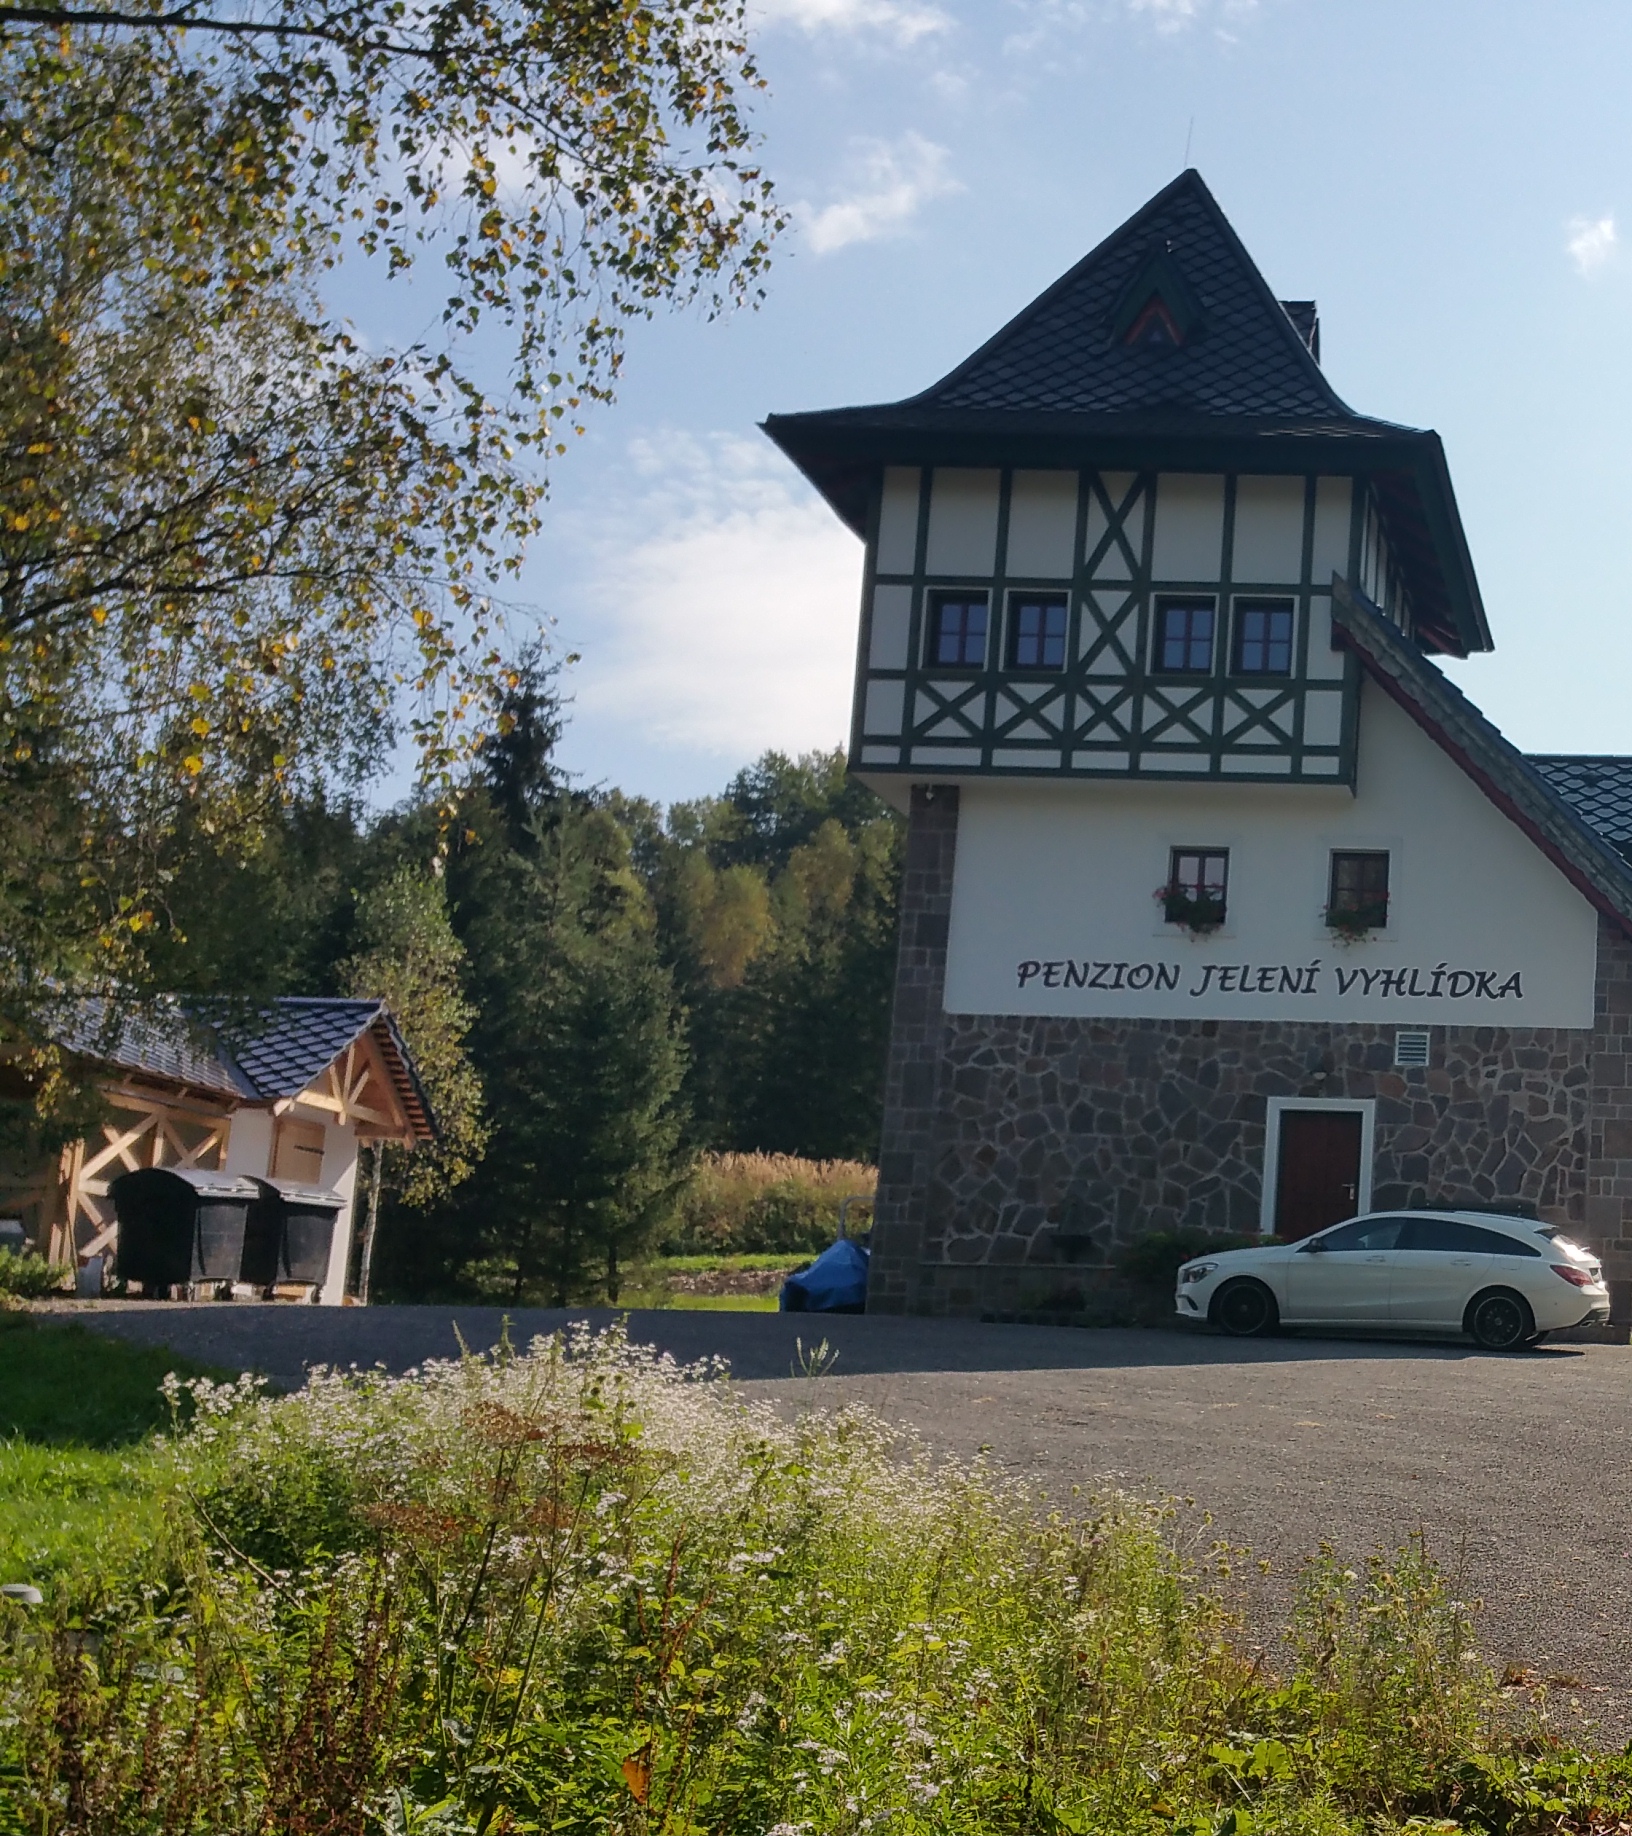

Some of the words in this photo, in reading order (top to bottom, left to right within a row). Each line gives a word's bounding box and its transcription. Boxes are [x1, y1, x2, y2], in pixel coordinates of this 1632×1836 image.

[1017, 960, 1181, 991] PENZION
[1189, 959, 1322, 997] JELENÍ
[1334, 962, 1523, 1000] VYHLÍDKA
